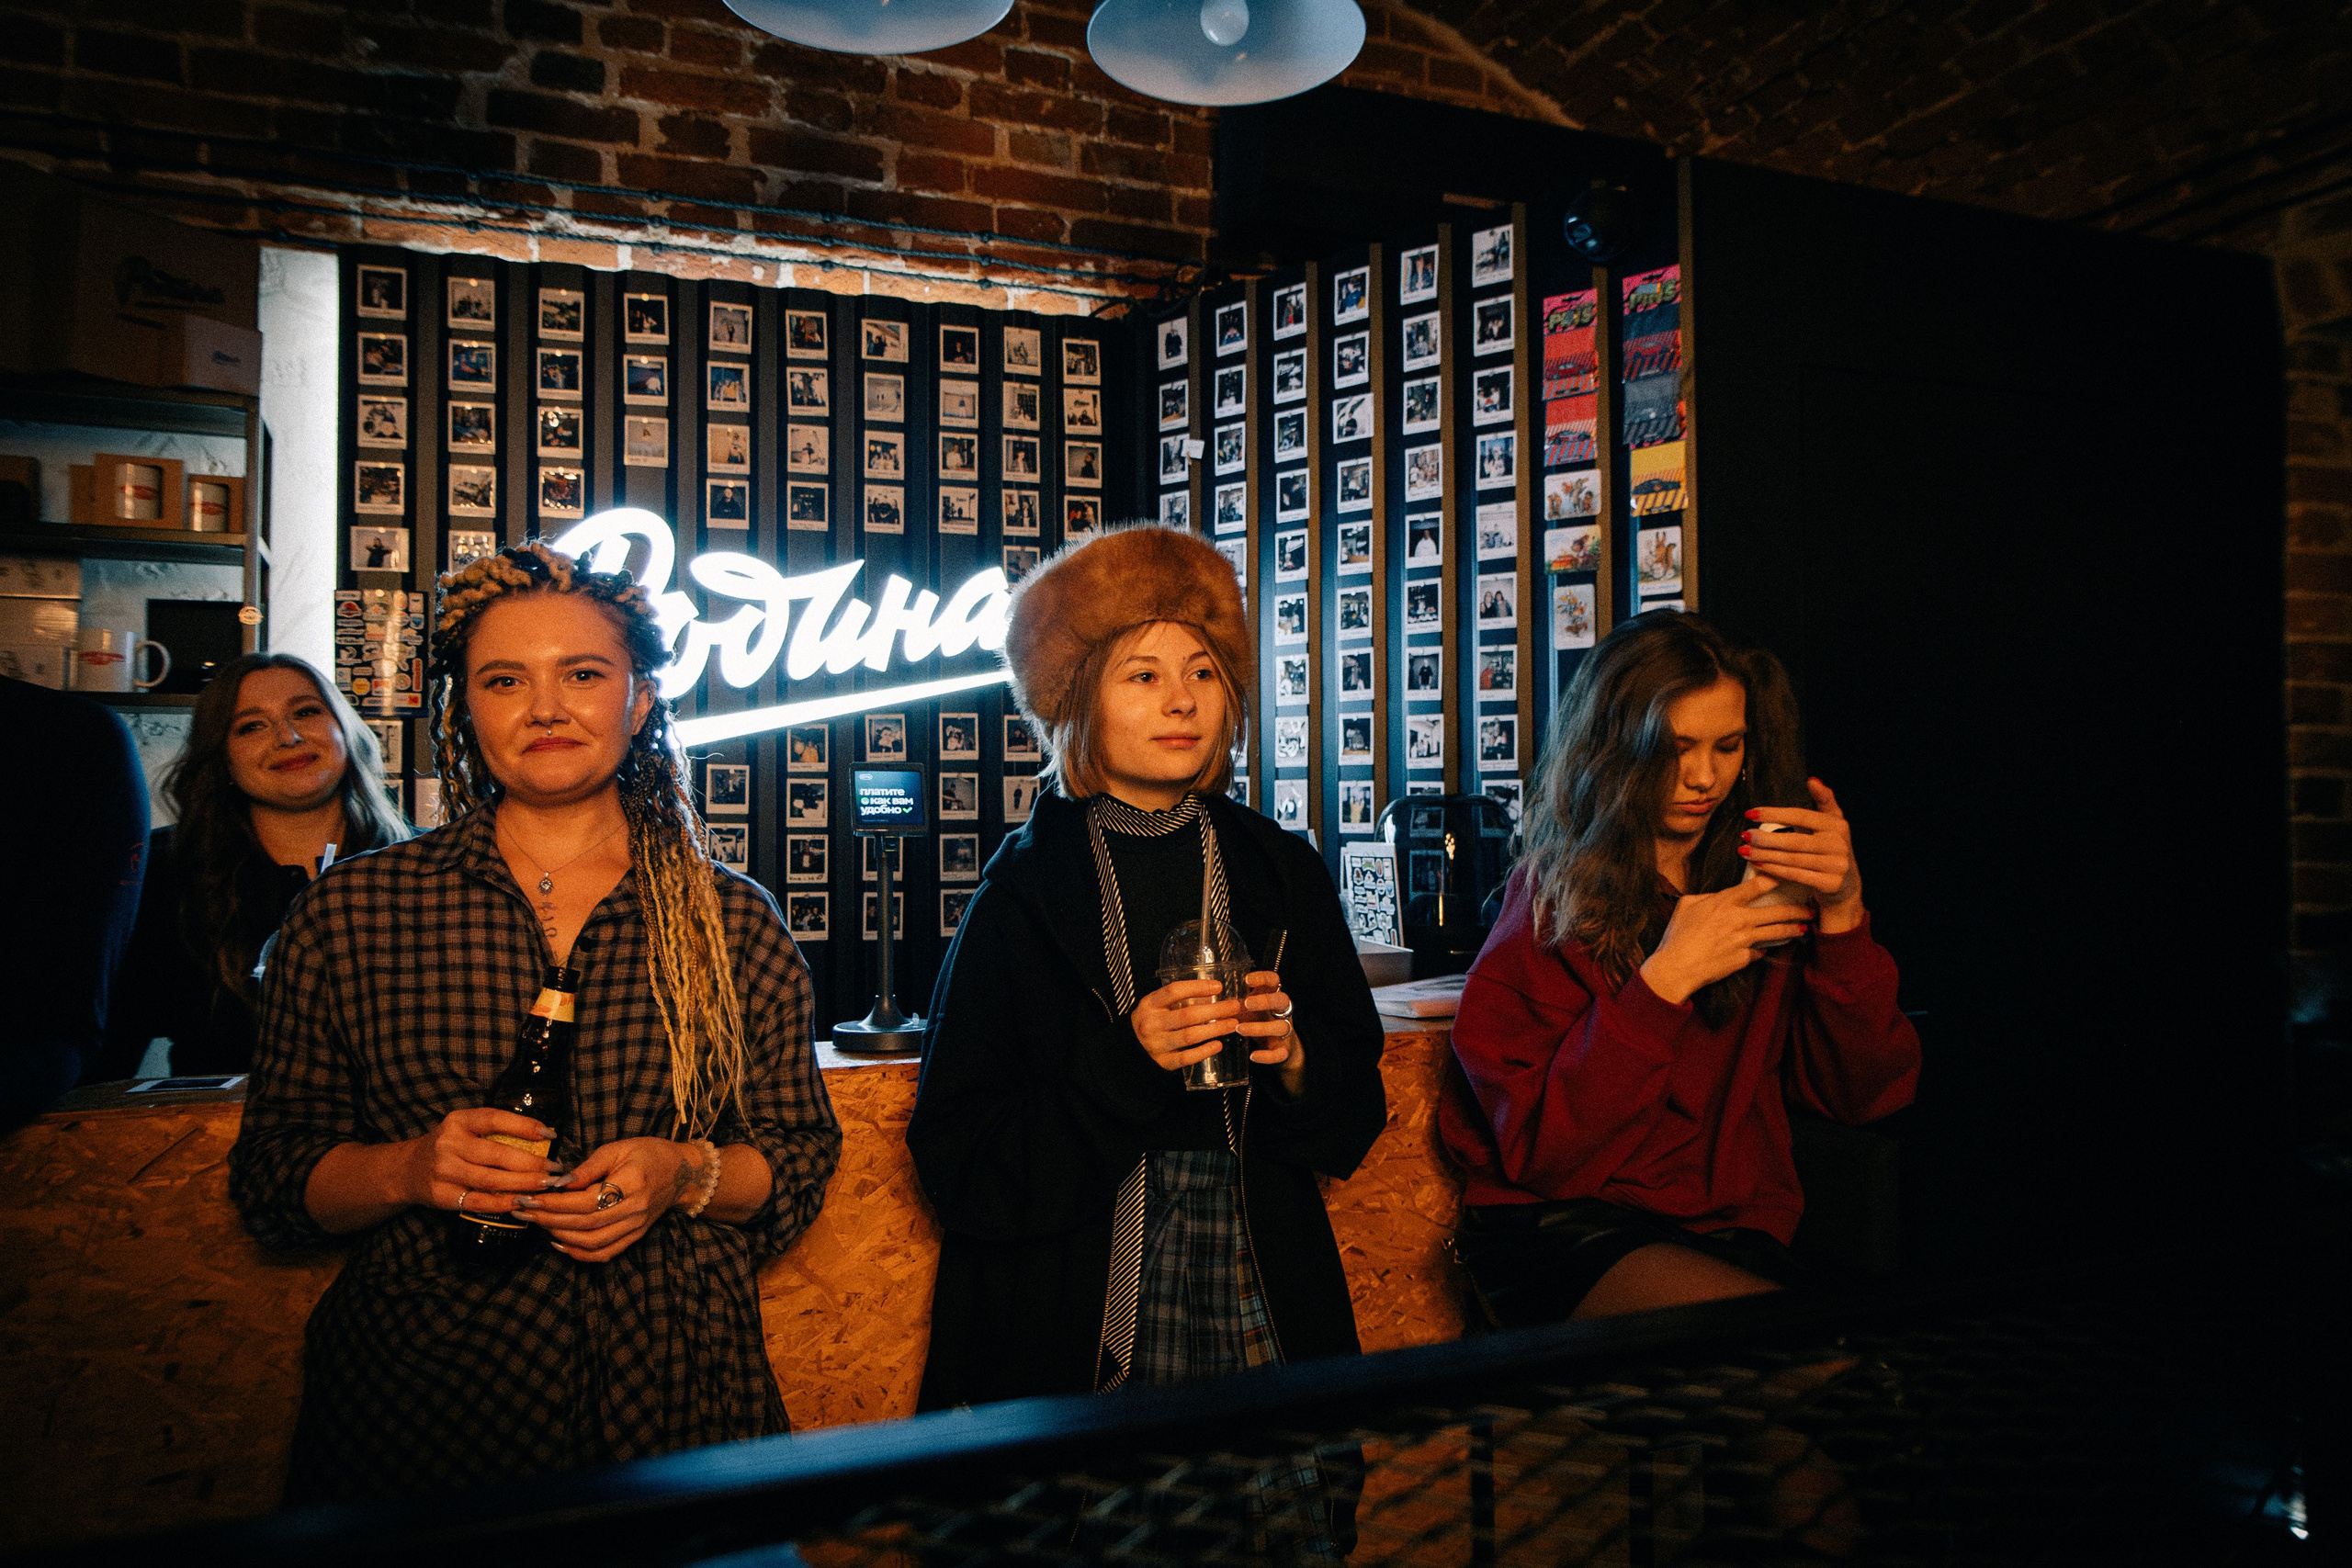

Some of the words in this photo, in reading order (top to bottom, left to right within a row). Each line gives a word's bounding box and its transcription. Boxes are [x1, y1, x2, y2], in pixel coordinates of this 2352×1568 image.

[859, 788, 905, 796] платите
[892, 797, 913, 806] вам
[860, 805, 902, 816] удобно
